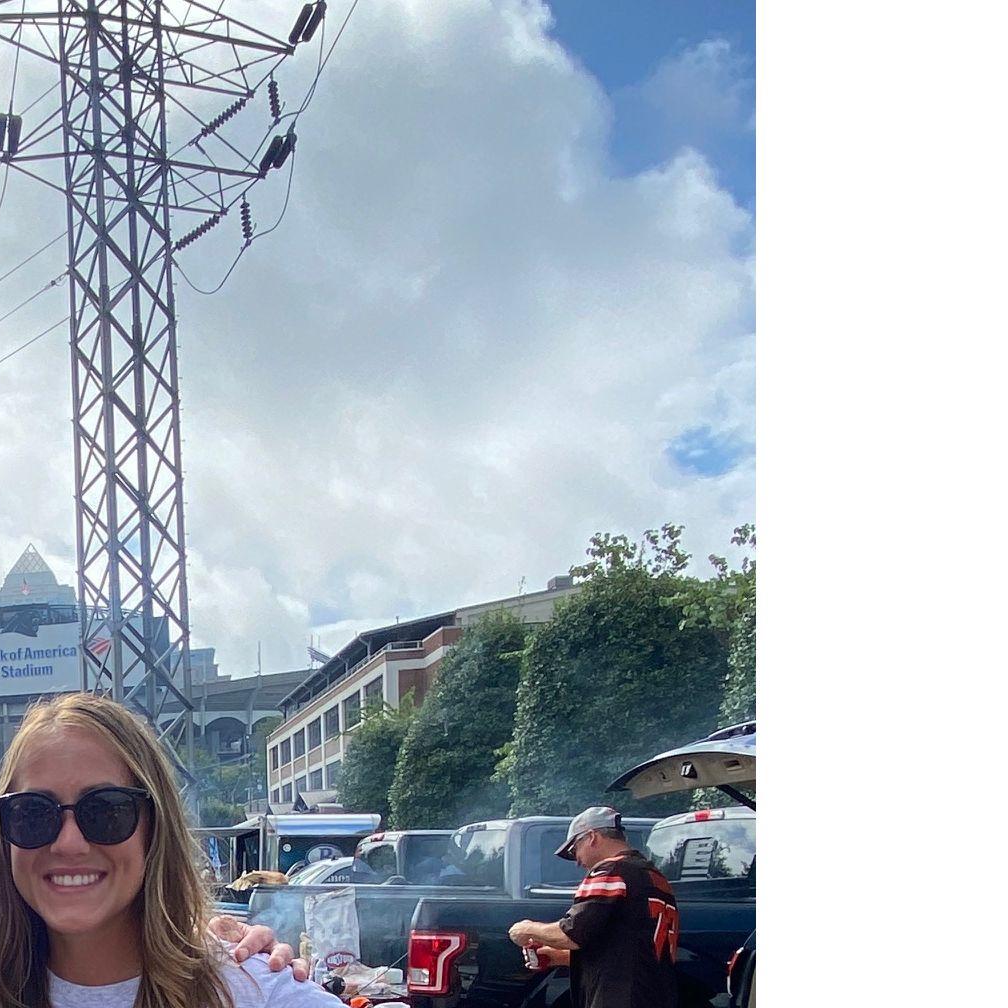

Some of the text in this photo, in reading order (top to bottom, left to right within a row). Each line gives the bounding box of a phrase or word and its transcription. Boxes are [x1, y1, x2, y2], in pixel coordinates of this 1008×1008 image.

[10, 648, 22, 661] of
[24, 645, 77, 660] America
[1, 664, 53, 678] Stadium
